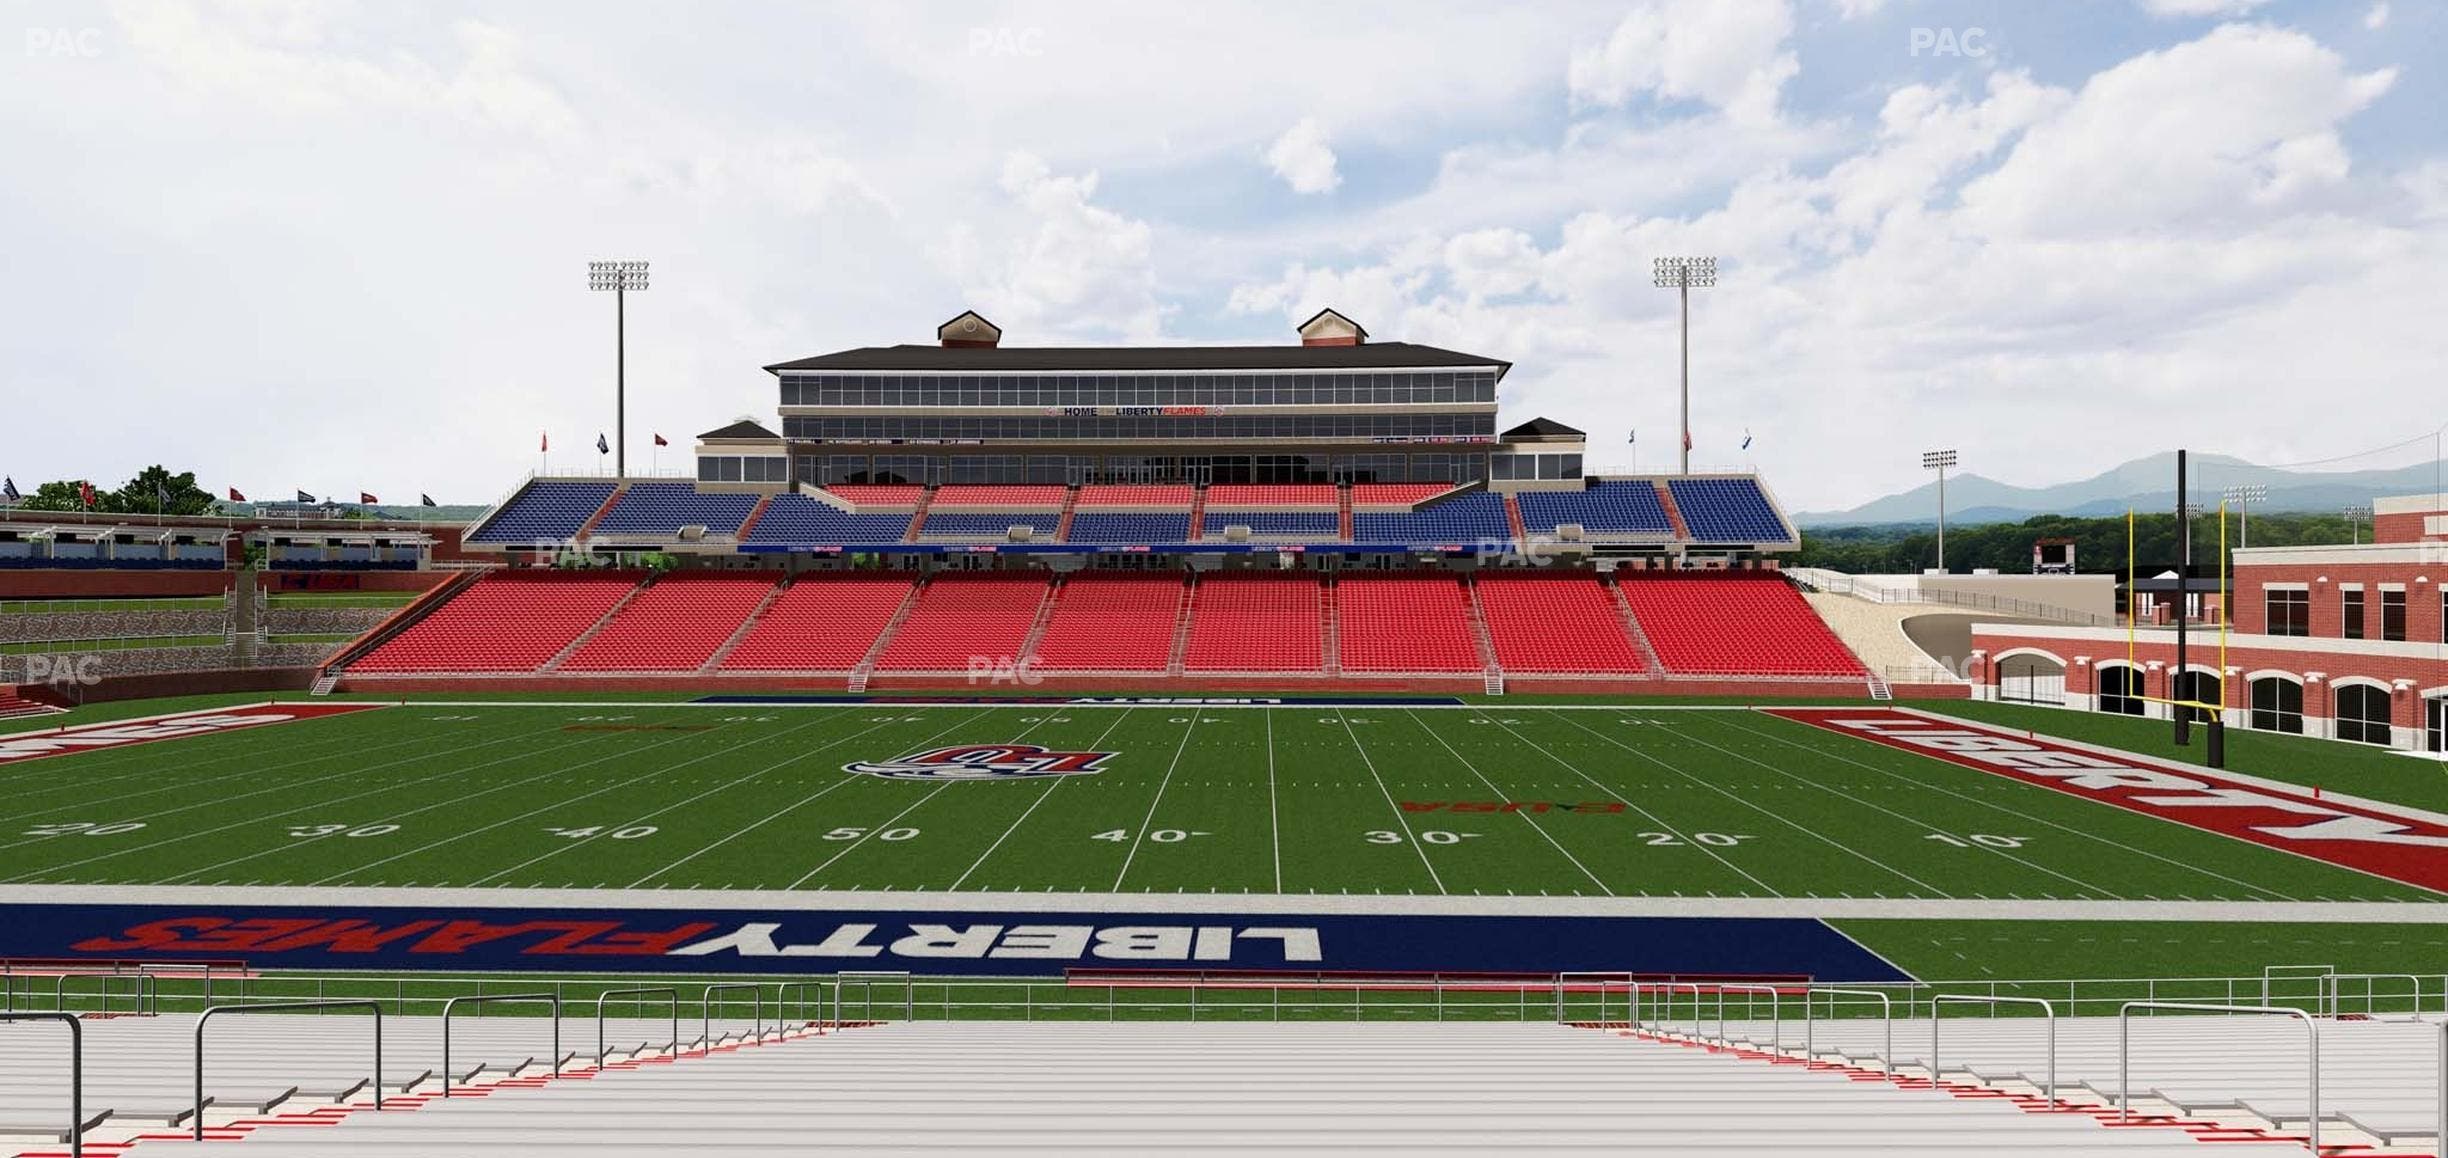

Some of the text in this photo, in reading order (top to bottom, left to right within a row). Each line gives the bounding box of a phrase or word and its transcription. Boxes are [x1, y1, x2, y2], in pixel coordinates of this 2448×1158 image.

[1064, 407, 1098, 416] HOME
[1824, 719, 2448, 847] LIBERTY
[289, 824, 401, 837] 30
[554, 826, 658, 839] 40
[822, 827, 920, 841] 50
[1090, 829, 1187, 842] 40
[1364, 830, 1460, 844] 30
[1636, 832, 1739, 846] 20
[1923, 834, 2022, 847] 10
